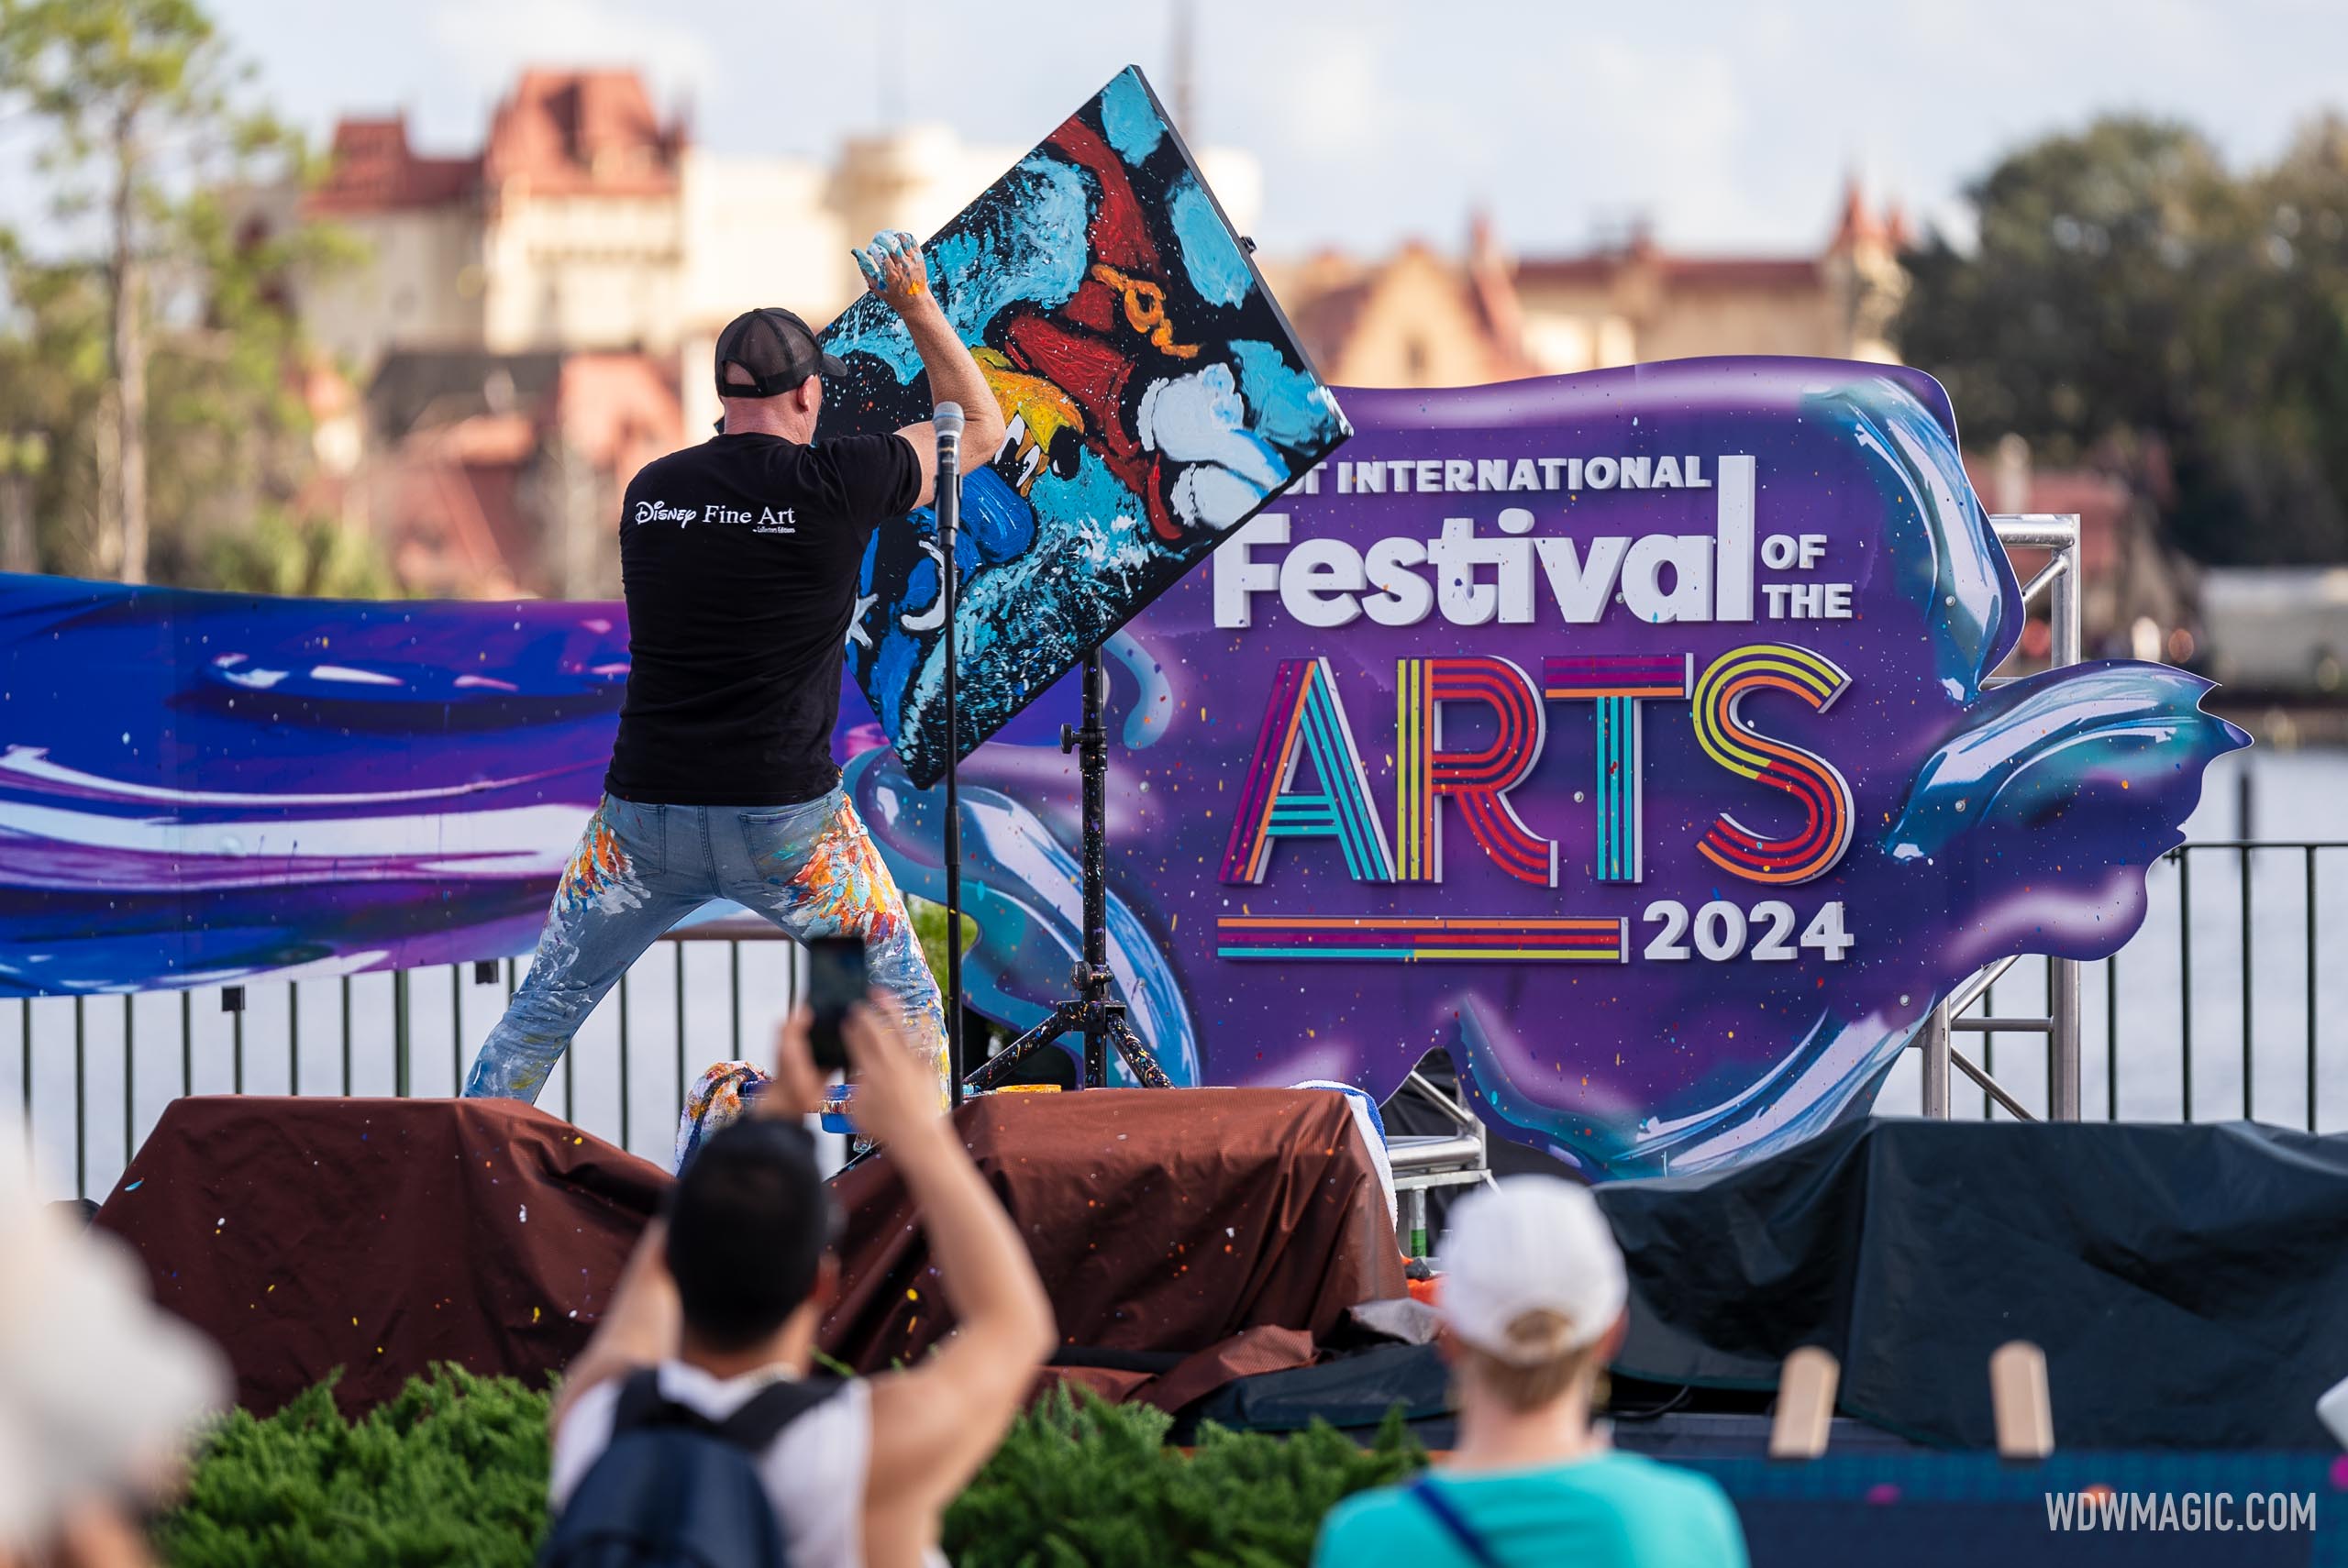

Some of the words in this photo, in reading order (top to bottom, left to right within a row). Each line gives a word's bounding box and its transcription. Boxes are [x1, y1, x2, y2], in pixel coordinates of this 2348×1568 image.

[1337, 455, 1712, 494] INTERNATIONAL
[635, 500, 697, 529] Disney
[703, 504, 752, 525] Fine
[758, 505, 796, 525] Art
[1213, 455, 1755, 628] Festival
[1761, 534, 1828, 570] OF
[1762, 582, 1854, 620] THE
[1218, 642, 1855, 888] ARTS
[1643, 900, 1855, 962] 2024
